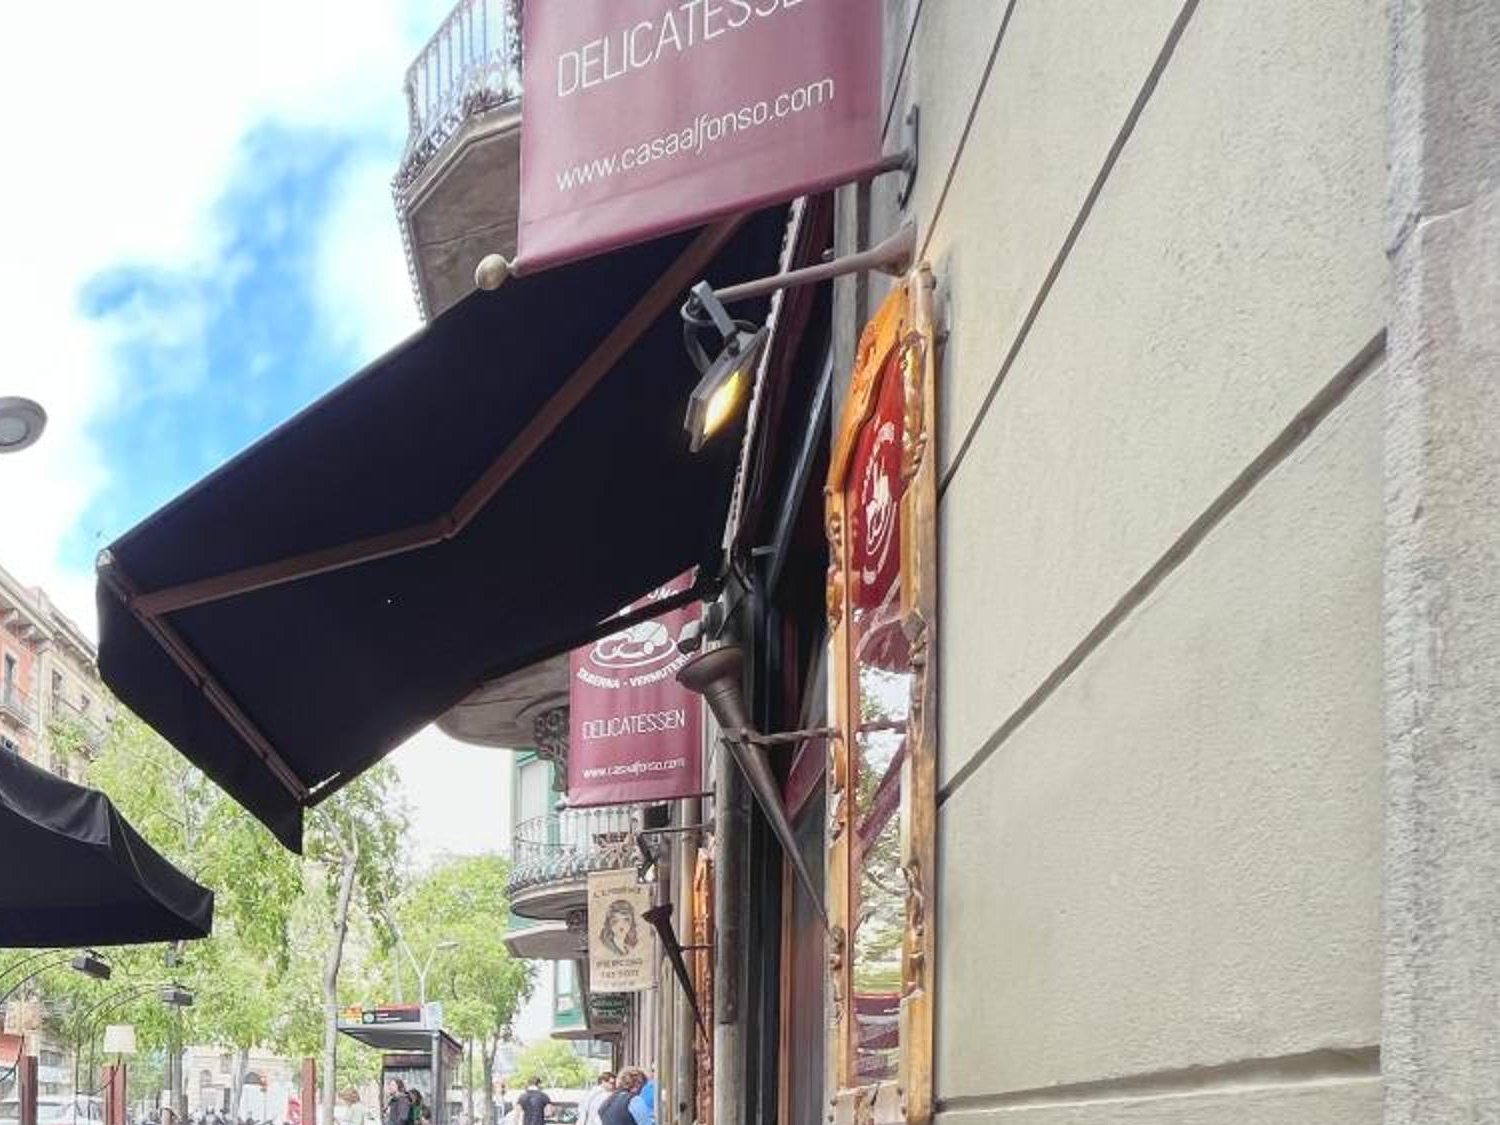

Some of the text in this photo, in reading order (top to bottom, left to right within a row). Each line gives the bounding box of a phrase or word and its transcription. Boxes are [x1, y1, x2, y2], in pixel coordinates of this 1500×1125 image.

[556, 0, 803, 97] DELICATES
[556, 77, 834, 192] www.casaalfonso.com
[582, 709, 686, 740] DELICATESSEN
